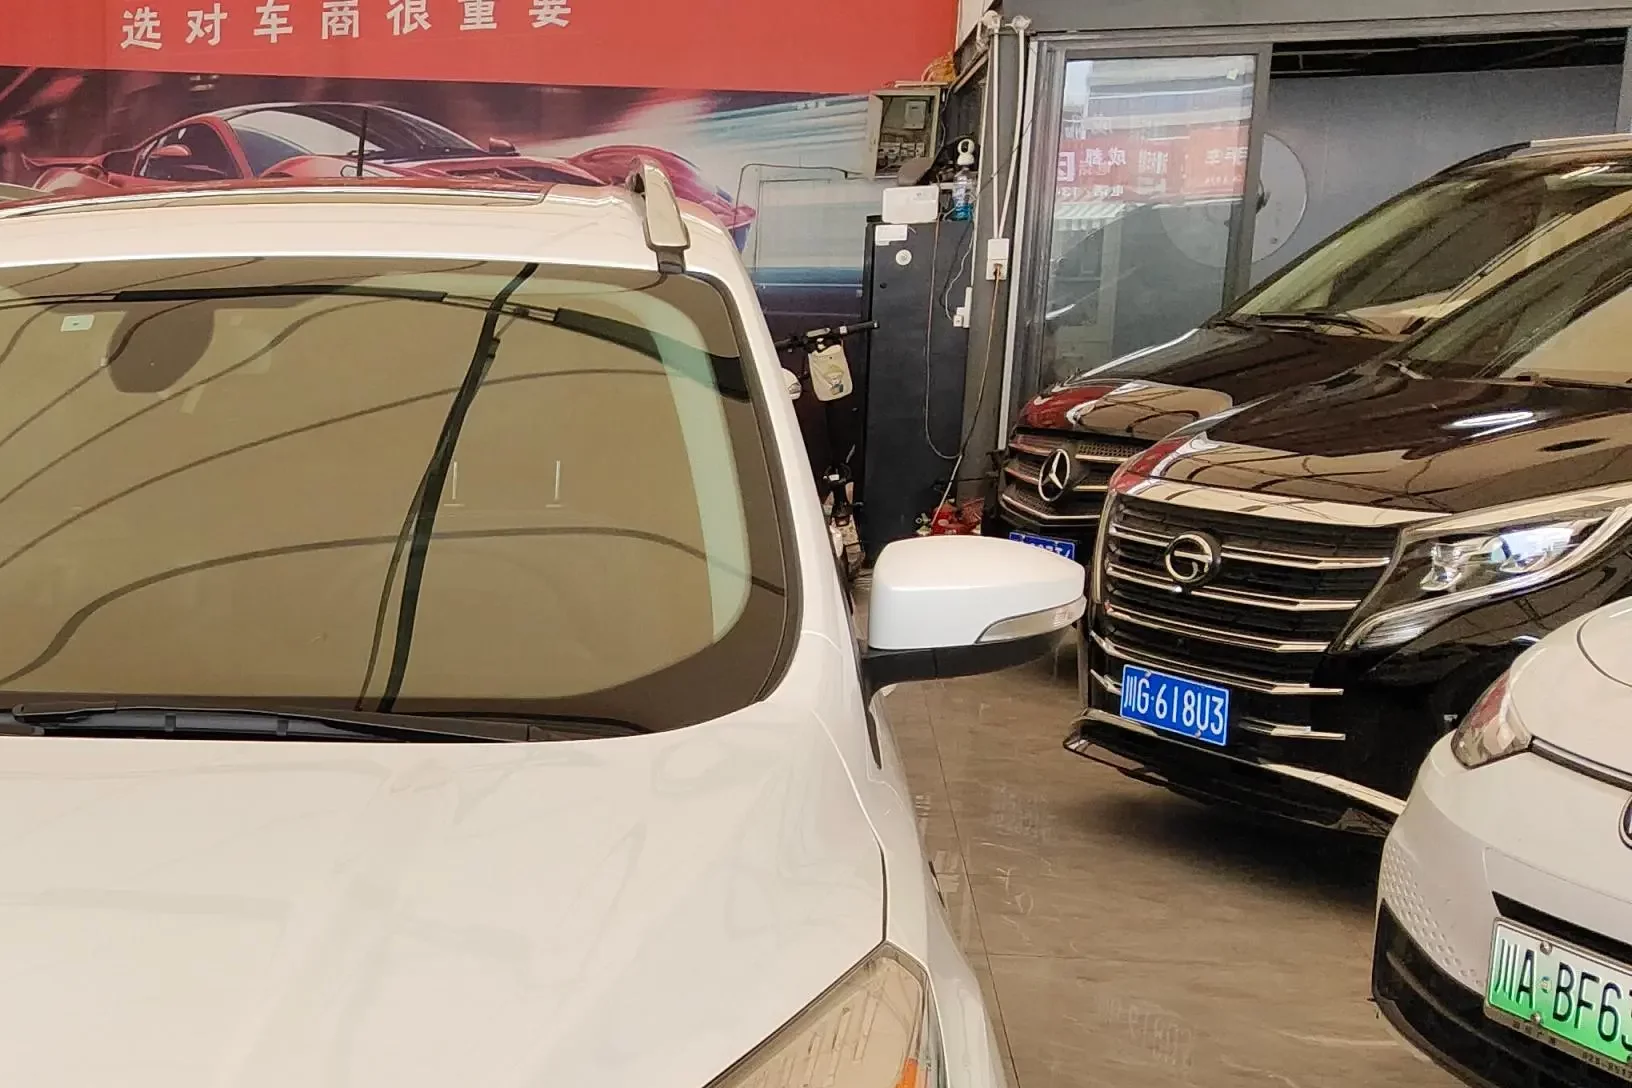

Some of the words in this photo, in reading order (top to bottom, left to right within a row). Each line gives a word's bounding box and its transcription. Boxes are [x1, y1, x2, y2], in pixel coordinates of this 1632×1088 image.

[120, 0, 573, 50] 选对车商很重要
[1124, 675, 1225, 735] 川G·618U3
